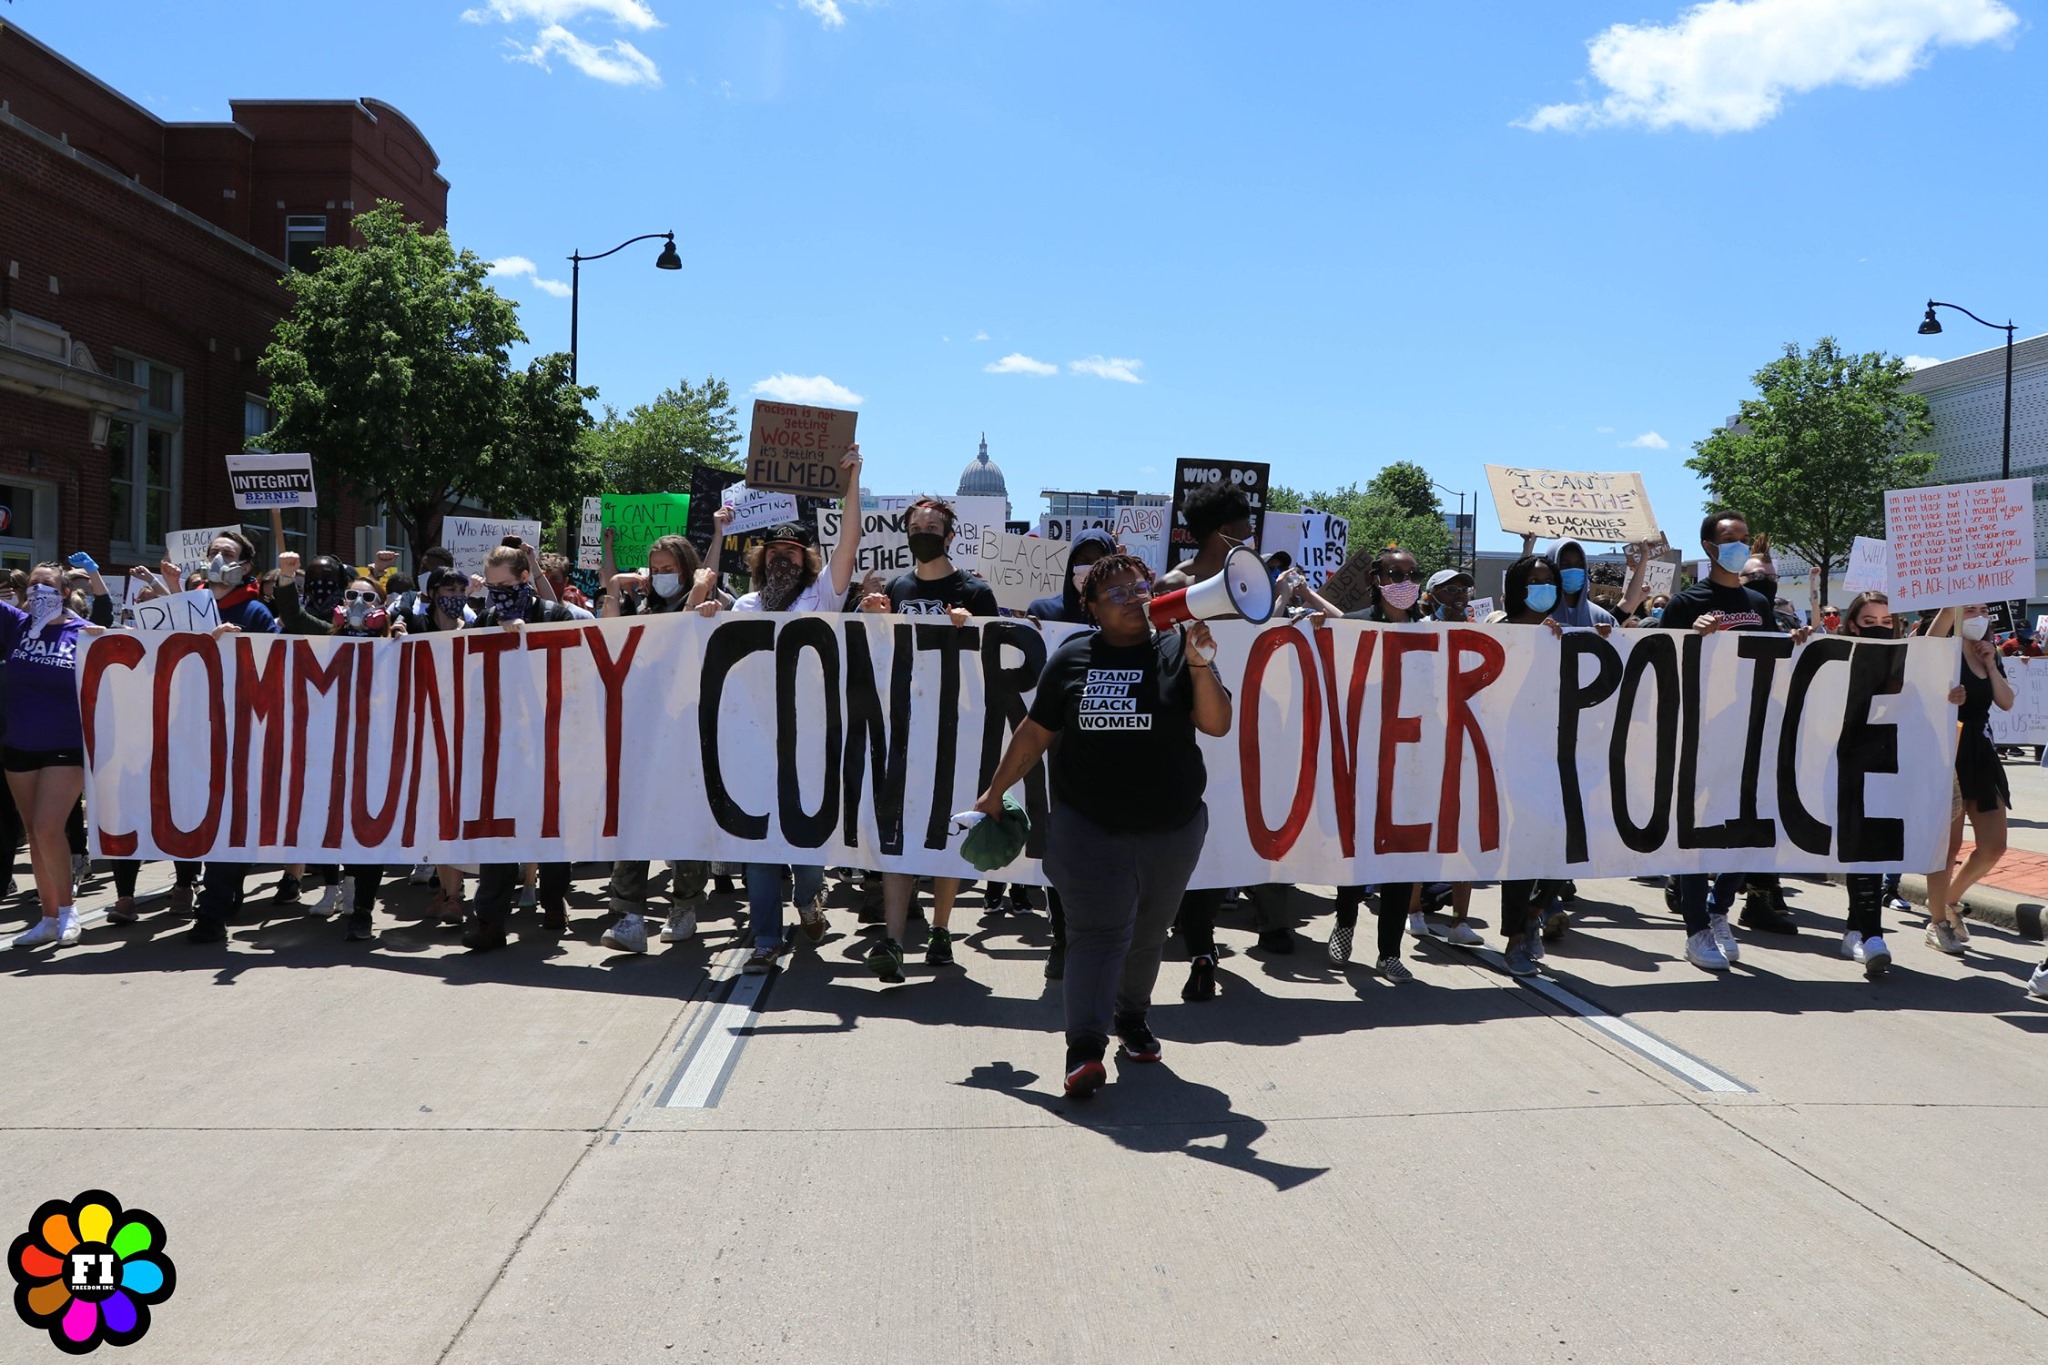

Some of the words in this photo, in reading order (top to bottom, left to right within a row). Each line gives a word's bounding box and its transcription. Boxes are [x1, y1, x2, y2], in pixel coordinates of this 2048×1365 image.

[757, 403, 797, 416] racism
[802, 407, 811, 417] is
[818, 411, 836, 420] not
[784, 419, 828, 432] getting
[760, 447, 777, 457] it's
[783, 448, 825, 462] getting
[233, 474, 309, 489] INTEGRITY
[753, 460, 840, 488] FILMED.
[1183, 467, 1222, 483] WHO
[1230, 468, 1258, 486] DO
[245, 491, 299, 501] BERNIE
[622, 503, 672, 523] CAN'T
[733, 500, 792, 521] POTTING
[480, 523, 499, 536] ARE
[502, 525, 519, 536] WE
[521, 526, 534, 536] AS
[1144, 533, 1160, 541] THE
[1562, 525, 1626, 539] MATTER
[182, 531, 212, 546] BLACK
[981, 530, 1067, 573] BLACK
[618, 555, 648, 566] LOYD
[1030, 571, 1065, 592] MAT
[1911, 577, 1944, 598] BLACK
[1948, 573, 1976, 594] LIVES
[1977, 569, 2014, 590] MATTER
[1088, 670, 1141, 682] STAND
[1086, 685, 1127, 695] WITH
[1081, 700, 1133, 710] BLACK
[1080, 716, 1150, 728] WOMEN
[80, 625, 645, 858] COMMUNITY
[699, 617, 1050, 860] CONTR
[1239, 626, 1507, 861] OVER
[1557, 631, 1908, 863] POLICE
